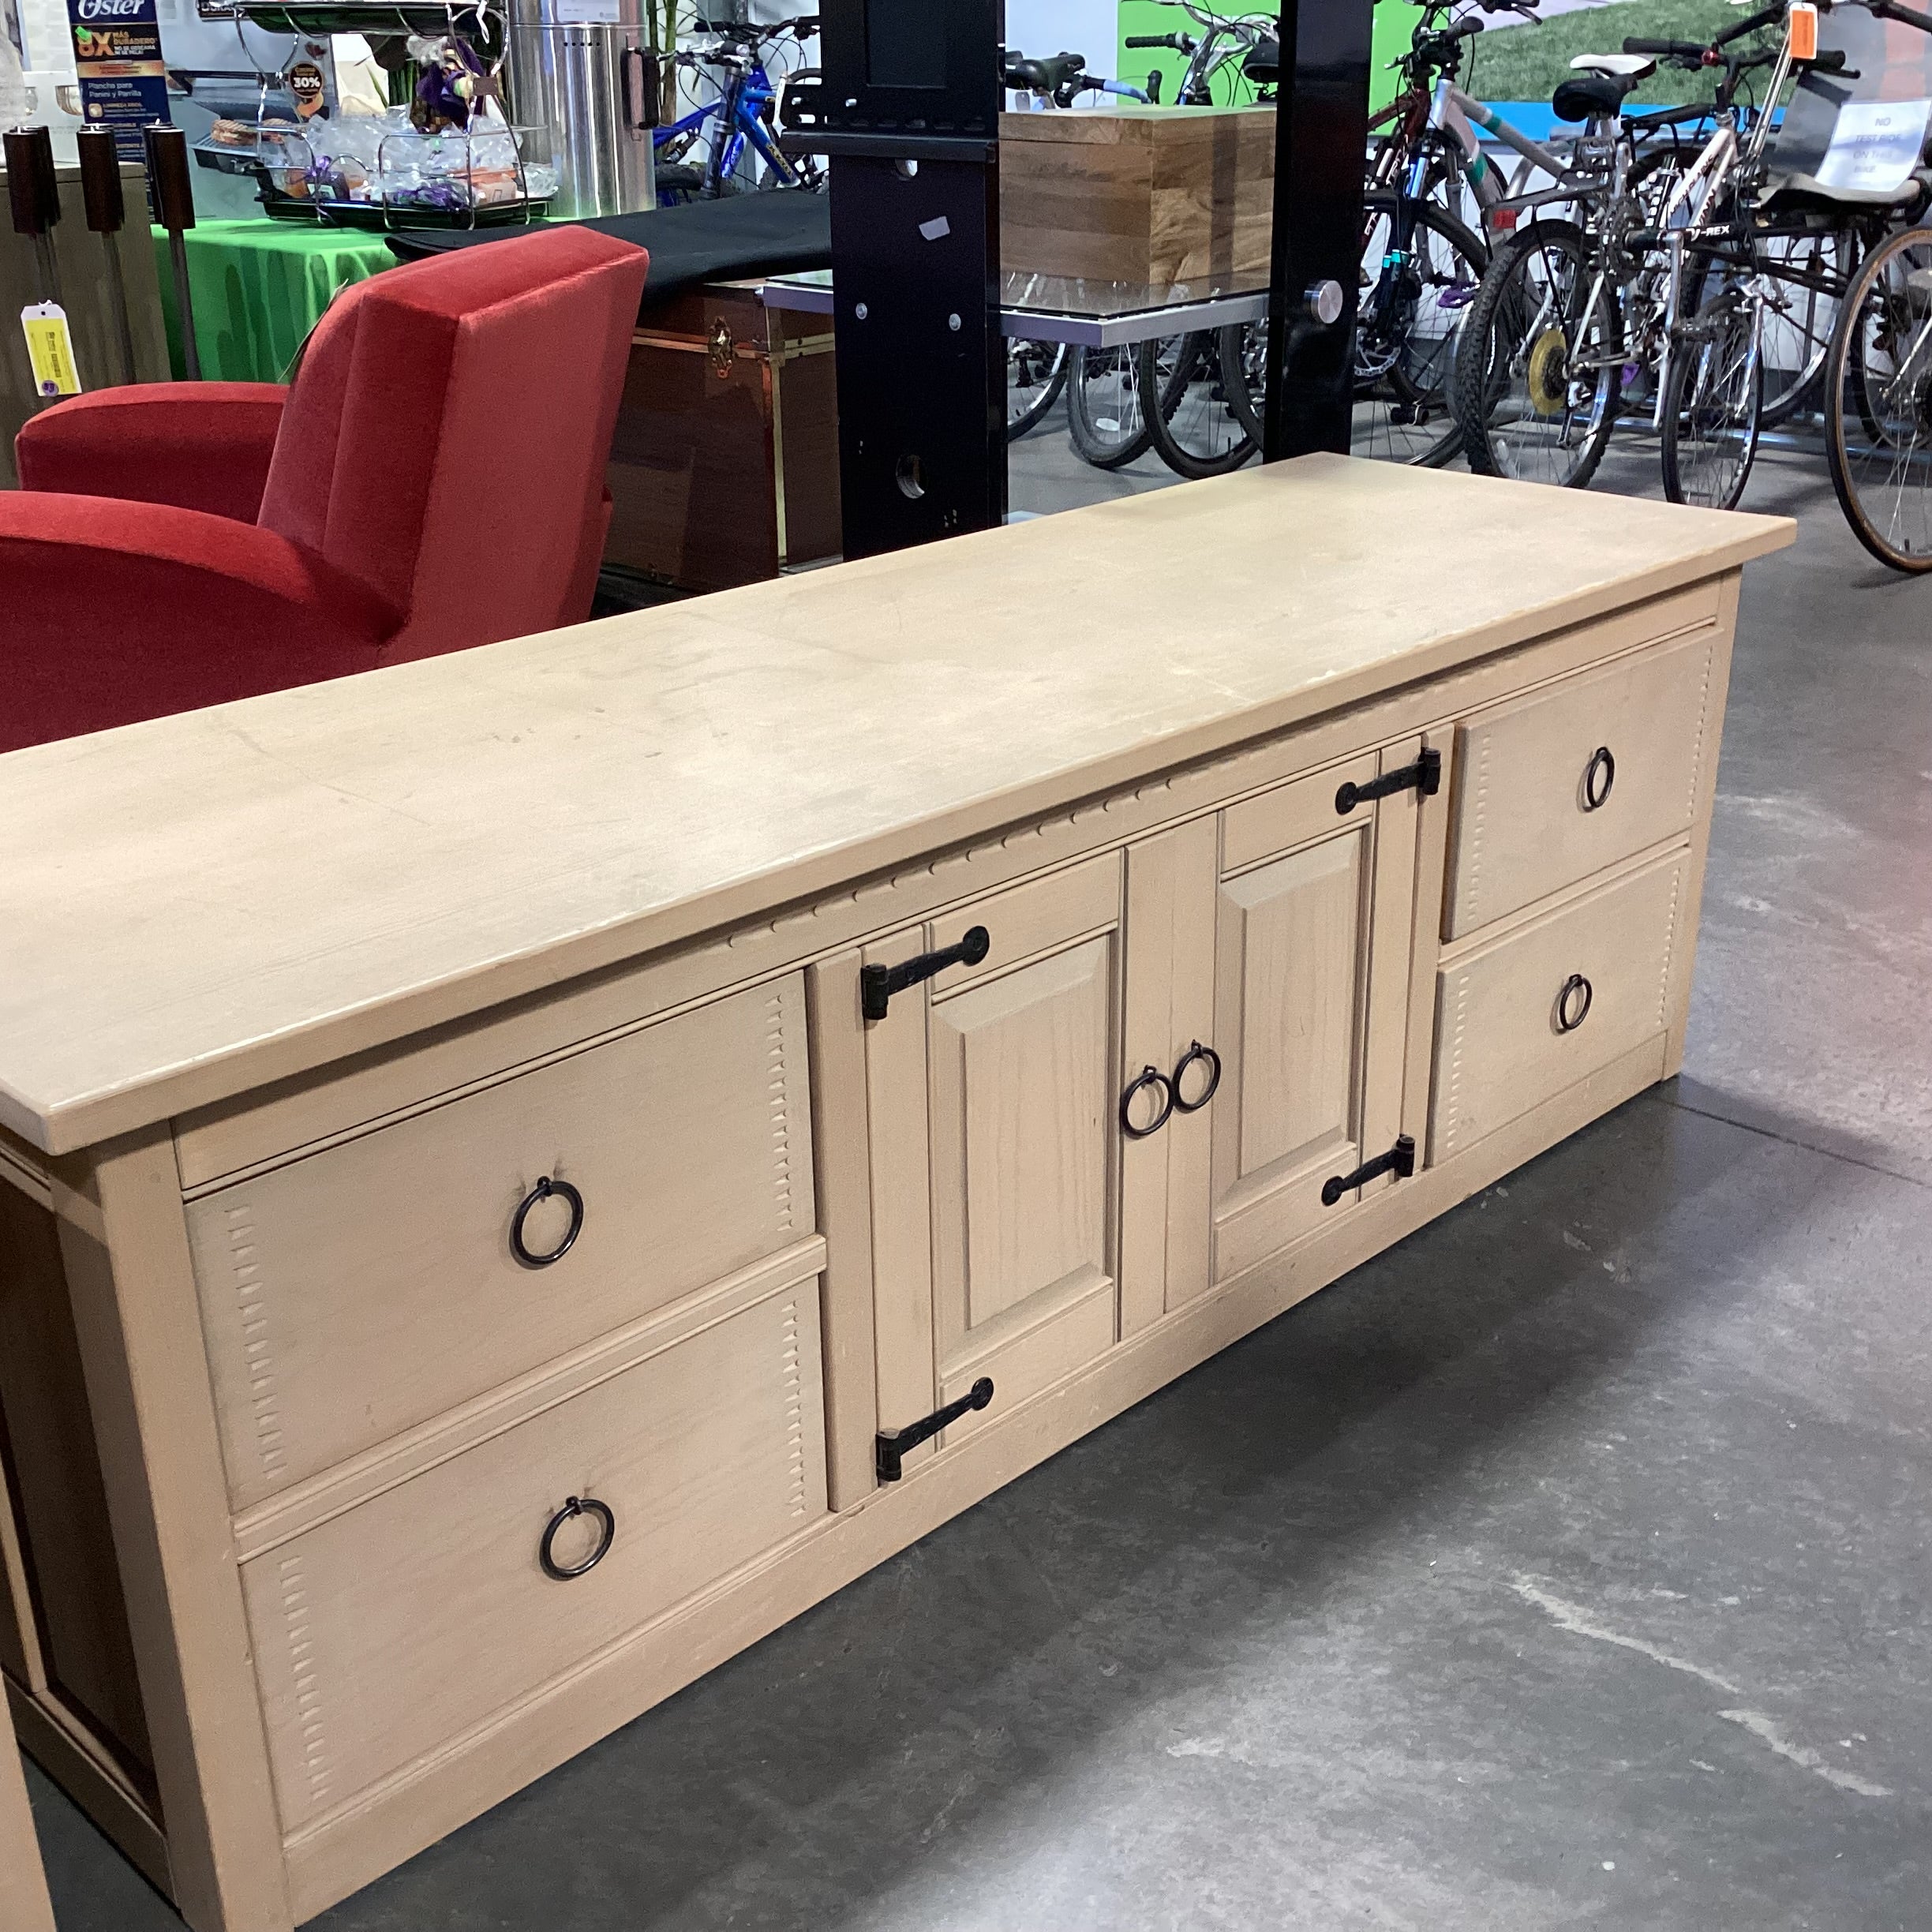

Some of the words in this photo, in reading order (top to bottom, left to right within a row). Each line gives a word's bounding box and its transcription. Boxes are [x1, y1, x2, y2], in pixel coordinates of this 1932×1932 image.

[78, 0, 144, 19] Oster
[294, 77, 320, 88] 30%
[1875, 117, 1892, 126] NO
[1855, 134, 1878, 143] TEST
[1853, 150, 1869, 159] ON
